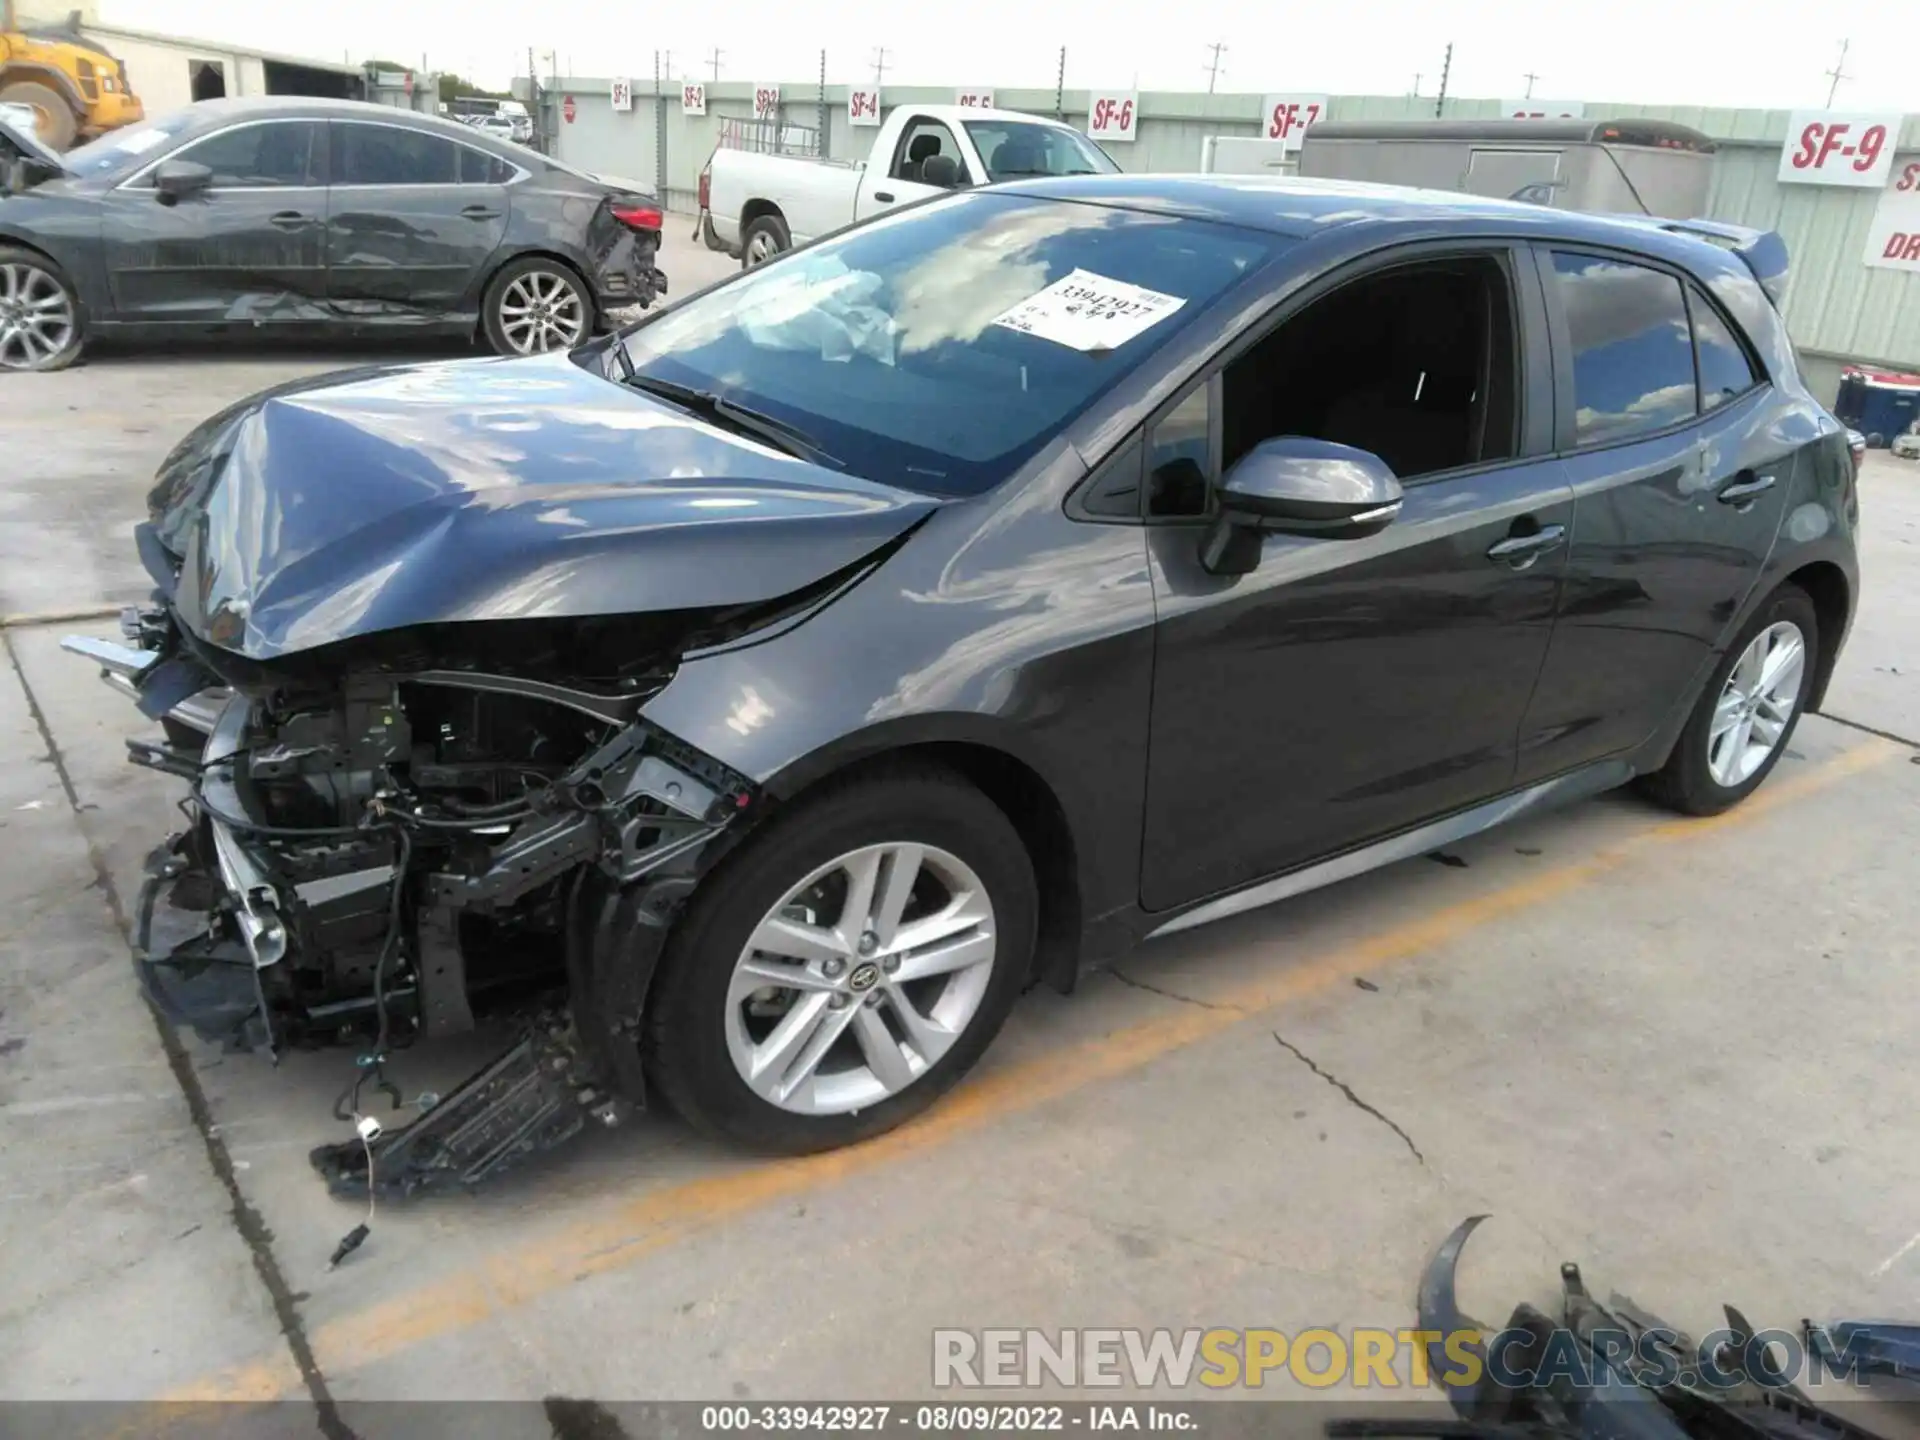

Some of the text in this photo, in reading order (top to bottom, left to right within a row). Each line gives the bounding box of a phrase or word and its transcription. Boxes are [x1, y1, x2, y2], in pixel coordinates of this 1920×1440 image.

[613, 84, 628, 104] SF-1
[684, 86, 702, 108] SF-2
[851, 91, 877, 118] SF-4
[1093, 98, 1133, 131] SF-6
[1269, 103, 1320, 139] SF-7
[1791, 121, 1888, 172] SF-9
